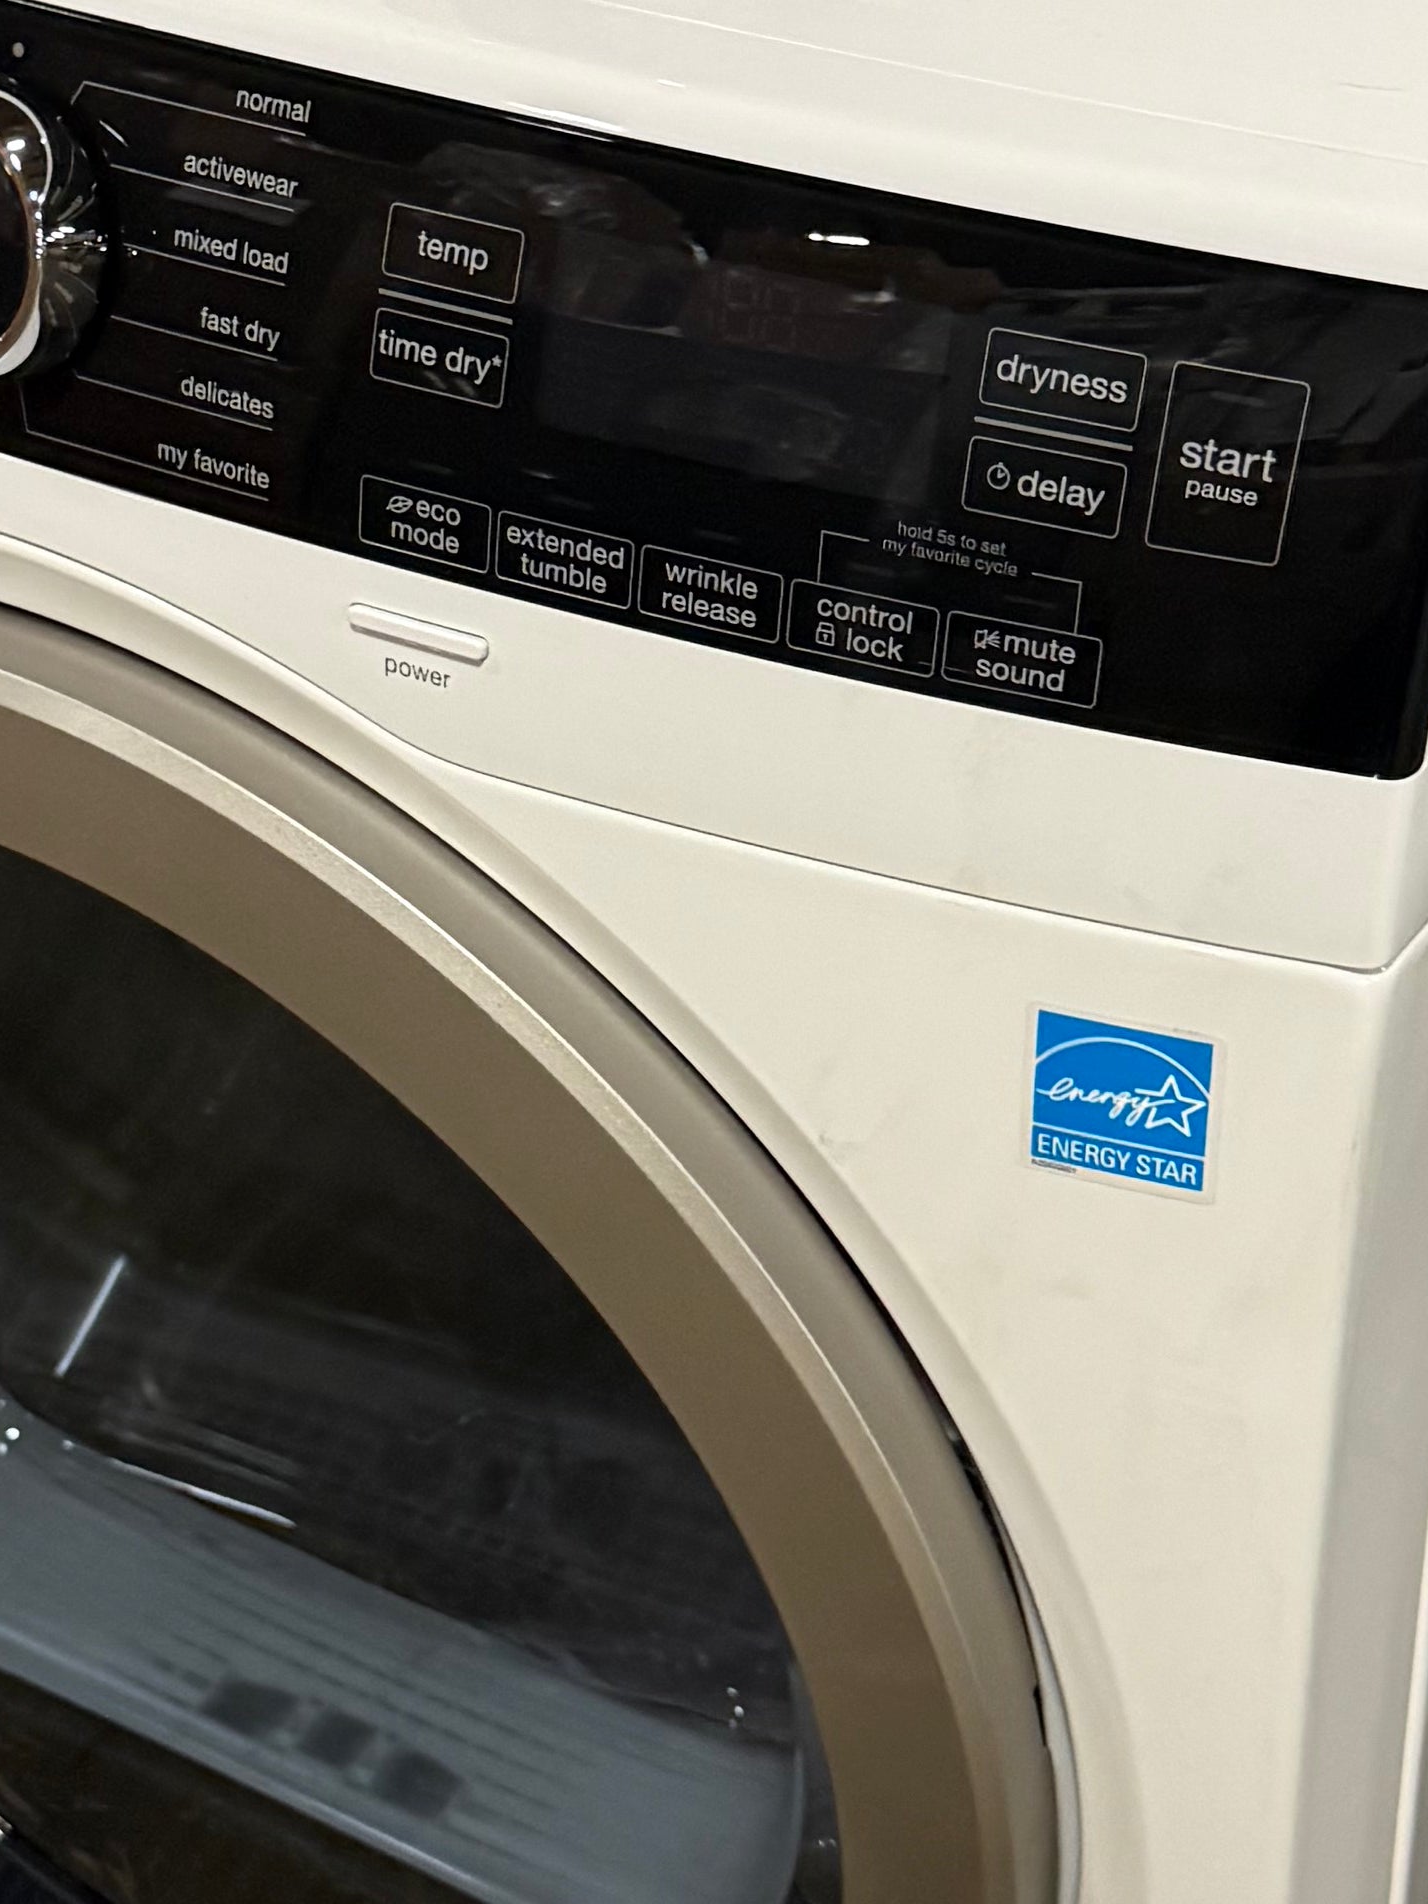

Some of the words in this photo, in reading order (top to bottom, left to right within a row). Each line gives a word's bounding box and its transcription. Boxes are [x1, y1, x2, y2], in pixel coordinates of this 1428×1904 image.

[235, 87, 312, 124] normal
[183, 152, 299, 199] activewear
[174, 227, 238, 262] mixed
[242, 241, 290, 275] load
[417, 230, 490, 276] temp
[199, 306, 239, 339] fast
[244, 320, 281, 352] dry
[379, 329, 437, 366] time
[180, 375, 275, 419] delicates
[995, 353, 1129, 404] dryness
[157, 441, 188, 471] my
[193, 448, 271, 490] favorite
[1179, 437, 1277, 485] start
[415, 498, 462, 528] eco
[1016, 469, 1106, 517] delay
[1184, 478, 1259, 508] pause
[390, 520, 461, 556] mode
[505, 522, 626, 571] extended
[882, 538, 907, 557] my
[911, 541, 971, 568] favorite
[974, 557, 1019, 577] cycle
[897, 519, 932, 542] hold
[936, 528, 956, 547] 5s
[960, 535, 977, 551] to
[980, 540, 1007, 557] set
[520, 550, 608, 594] tumble
[665, 559, 759, 601] wrinkle
[661, 587, 757, 629] release
[816, 597, 914, 636] control
[845, 627, 905, 664] lock
[1003, 633, 1077, 666] mute
[382, 654, 452, 691] power
[975, 656, 1067, 693] sound
[1037, 1132, 1131, 1170] ENERGY
[1135, 1152, 1198, 1185] STAR
